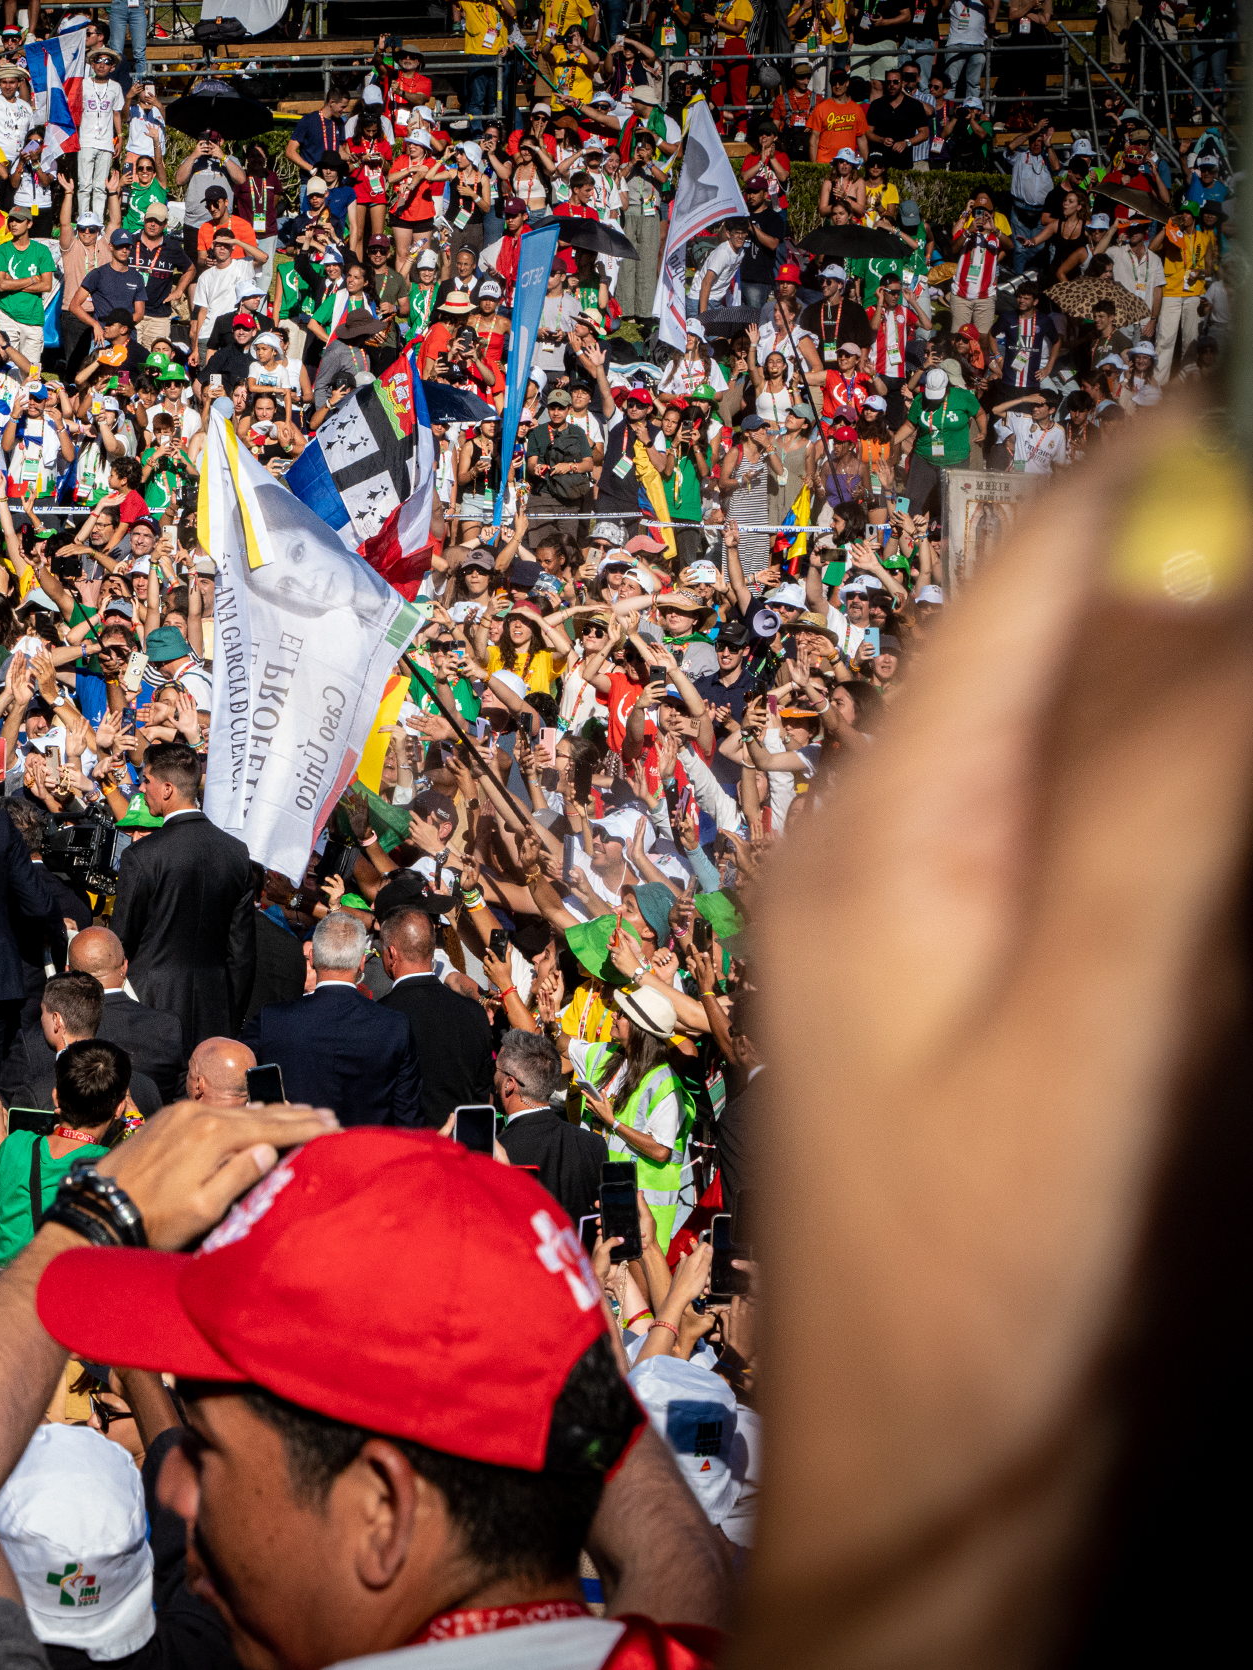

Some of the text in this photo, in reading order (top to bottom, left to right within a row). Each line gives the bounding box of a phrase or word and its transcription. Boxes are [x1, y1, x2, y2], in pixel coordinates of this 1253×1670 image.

[128, 257, 173, 269] TOMMY
[1024, 440, 1053, 459] Emirates
[214, 585, 237, 626] ANA
[221, 626, 251, 698] GARCÍA
[62, 1129, 96, 1144] ASCAIS
[696, 1421, 723, 1441] JMJ
[694, 1438, 722, 1447] LISBOA
[79, 1585, 101, 1598] JMJ
